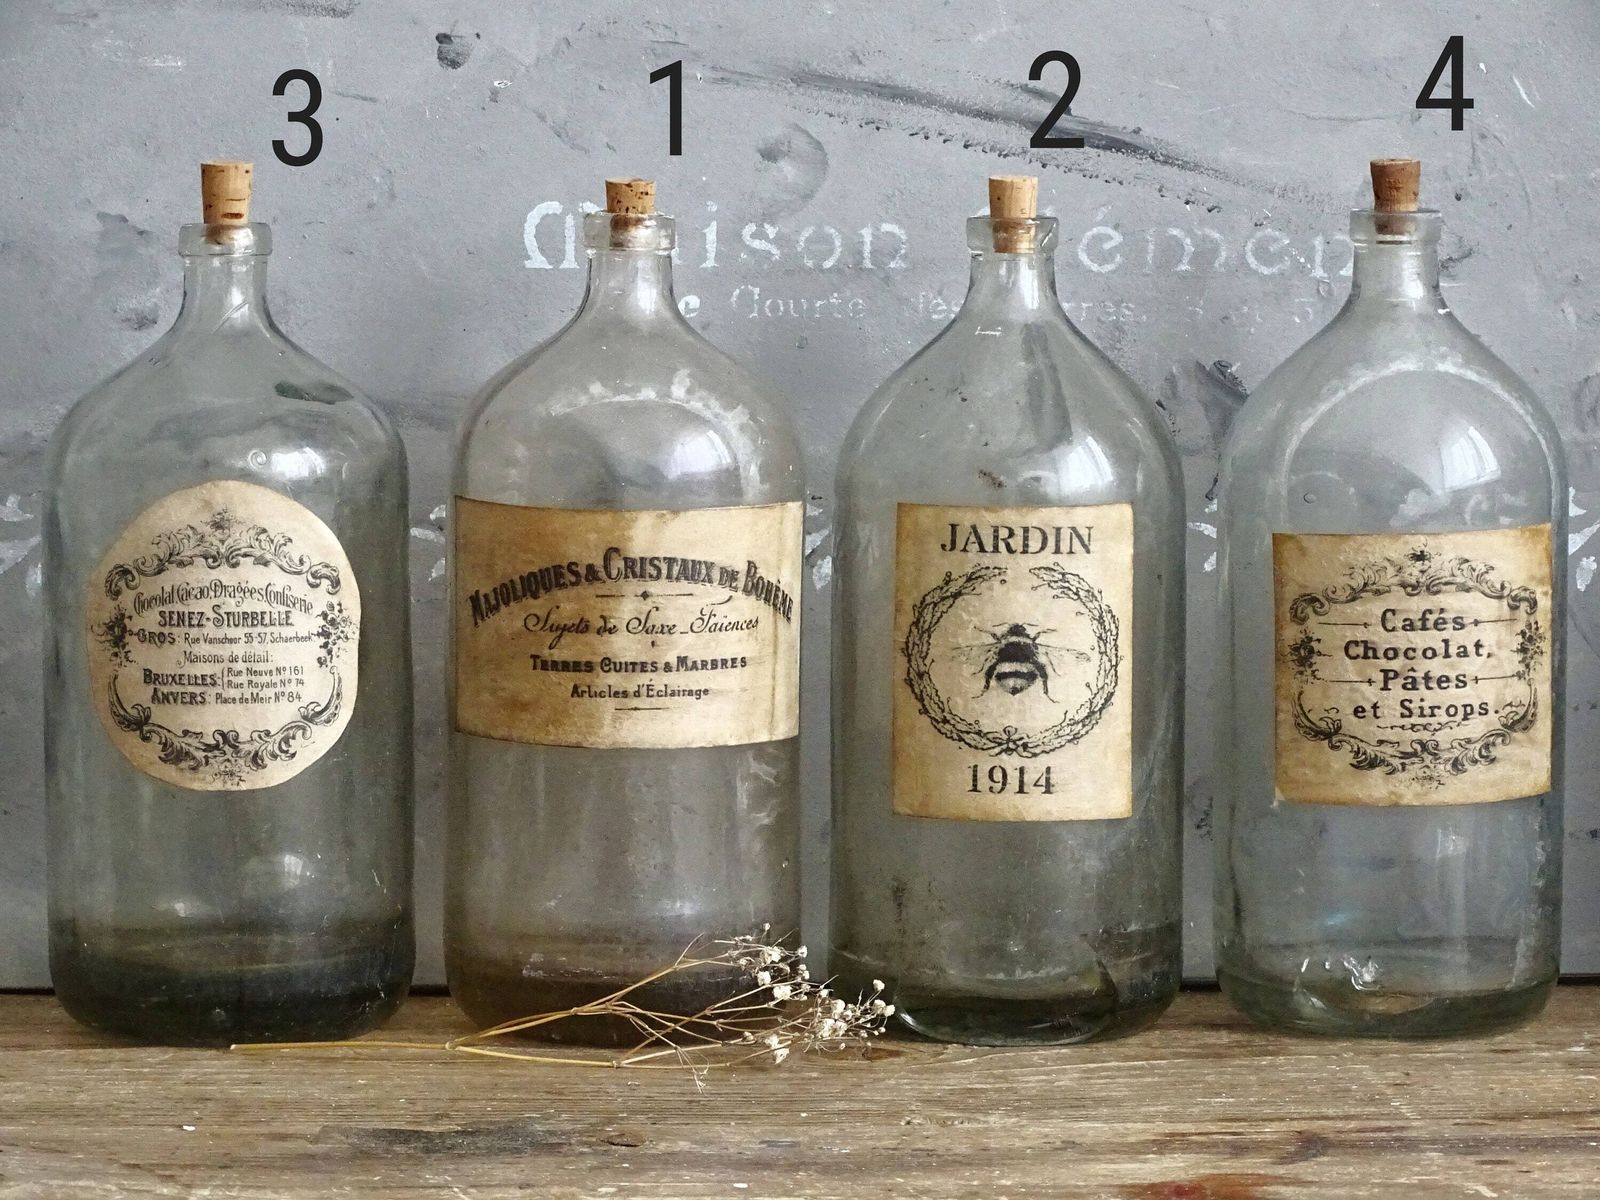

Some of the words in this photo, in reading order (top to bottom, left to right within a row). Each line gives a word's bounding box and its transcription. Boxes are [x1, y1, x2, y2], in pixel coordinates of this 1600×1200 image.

[941, 523, 1094, 555] JARDIN
[584, 563, 603, 583] &
[602, 547, 714, 584] CRISTAUX
[596, 615, 618, 637] de
[1380, 607, 1467, 633] Cafés
[184, 633, 200, 648] Rue
[176, 651, 225, 669] Maisons
[228, 651, 240, 664] de
[530, 654, 594, 672] TERRES
[600, 656, 658, 673] CUITES
[664, 661, 673, 673] &
[676, 655, 748, 673] MARBRES
[227, 667, 243, 677] Rue
[246, 667, 274, 677] Neuve
[289, 665, 304, 676] 161
[1379, 666, 1468, 692] Pâtes
[227, 679, 244, 689] Rue
[247, 679, 278, 692] Royale
[295, 679, 305, 687] 74
[570, 683, 629, 699] Articles
[215, 692, 237, 704] Place
[238, 692, 250, 704] de
[250, 691, 272, 704] Meir
[1353, 700, 1381, 720] et
[1400, 698, 1500, 722] Sirops.
[967, 763, 1055, 795] 1914
